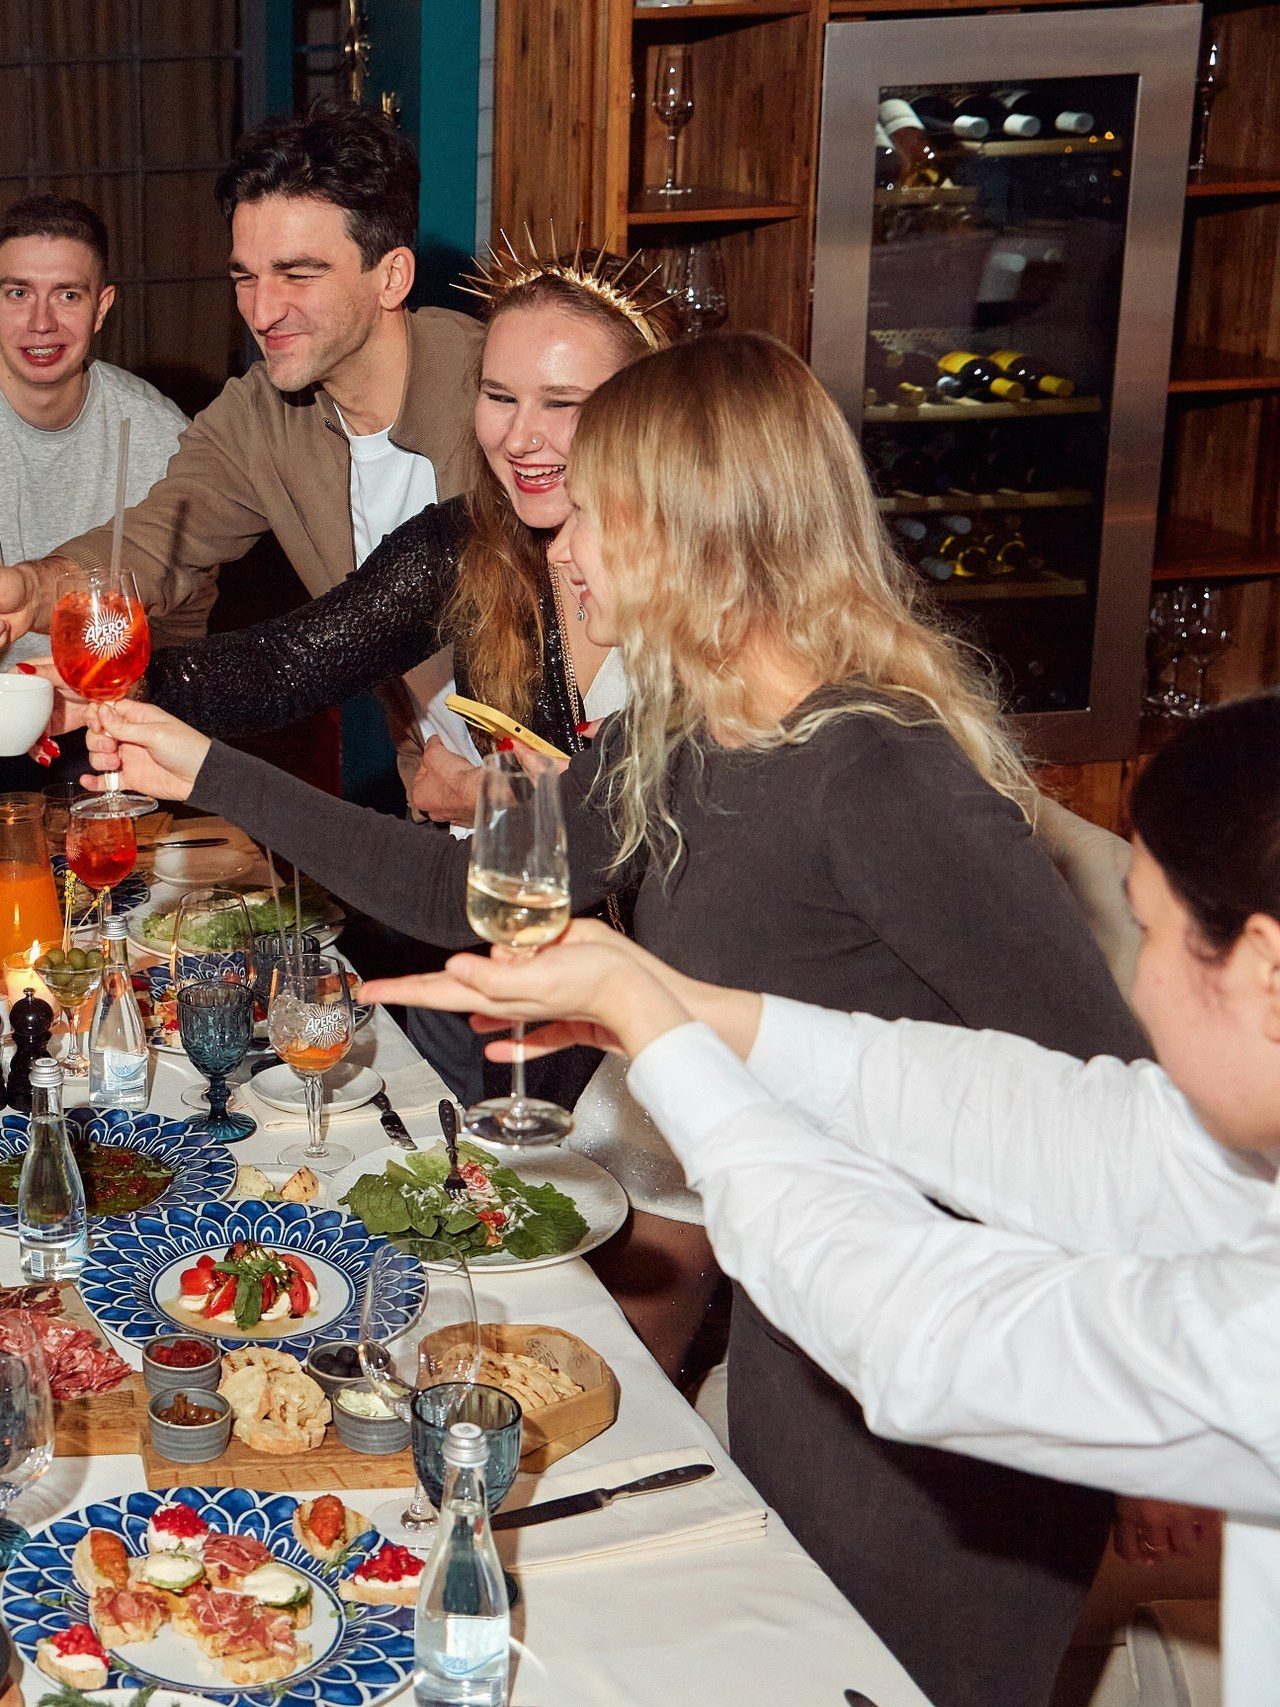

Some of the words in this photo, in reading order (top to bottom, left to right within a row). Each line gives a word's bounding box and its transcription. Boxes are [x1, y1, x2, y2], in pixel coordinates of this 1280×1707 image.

[85, 616, 130, 643] APEROL
[94, 629, 124, 649] SPRITZ
[305, 1007, 343, 1033] APEROL
